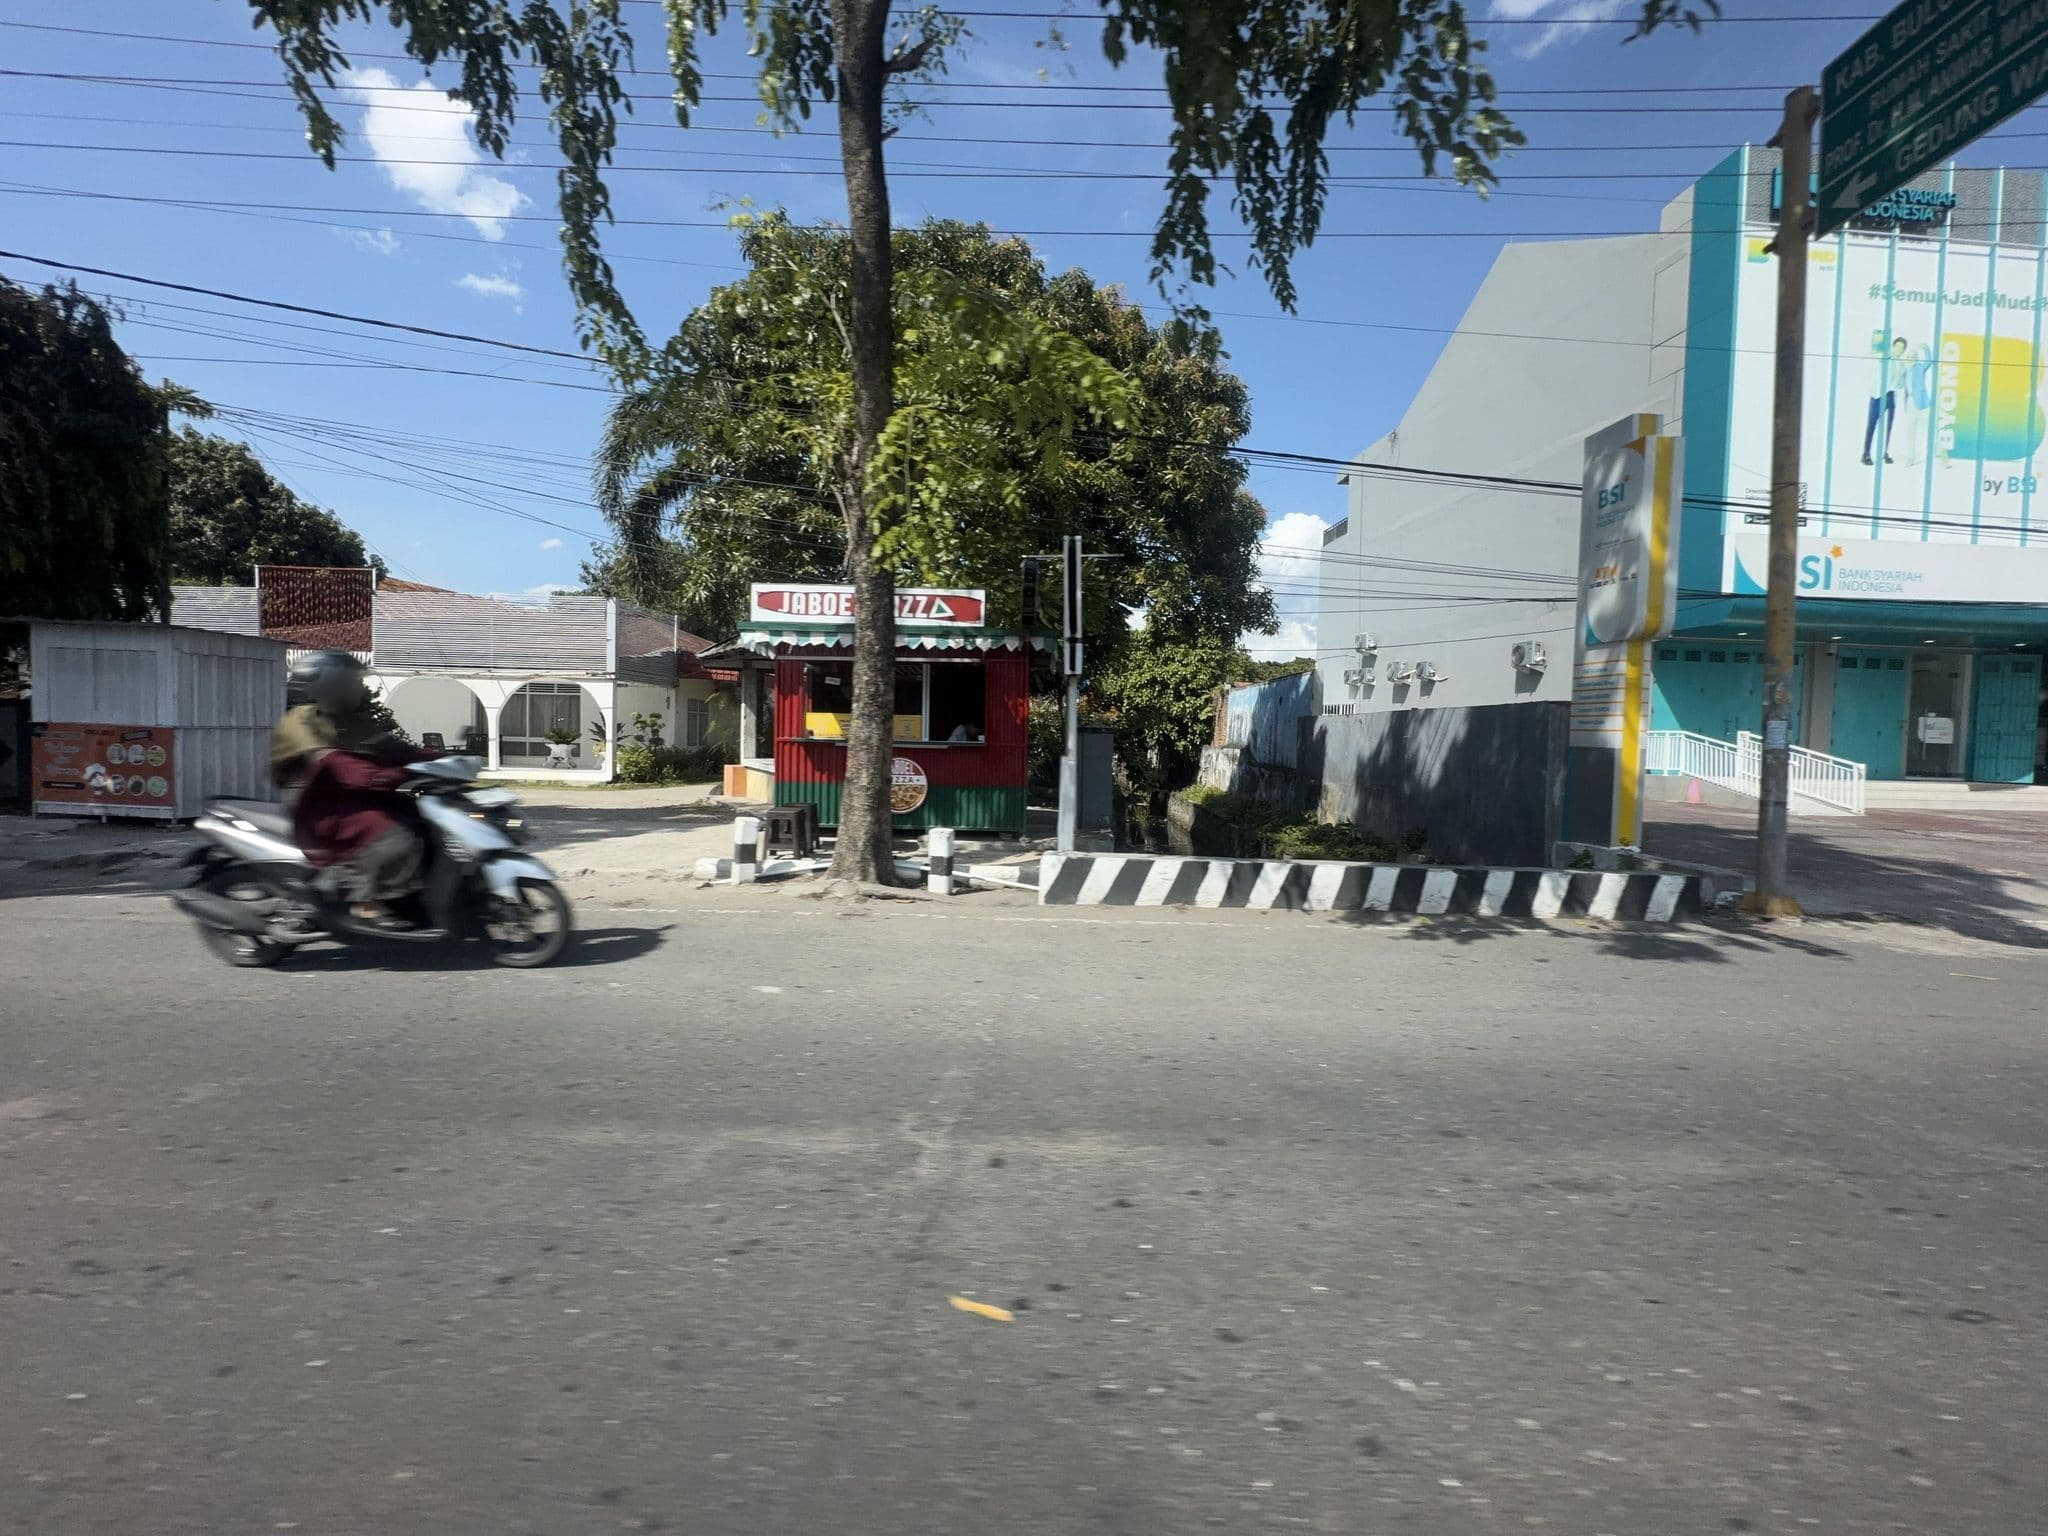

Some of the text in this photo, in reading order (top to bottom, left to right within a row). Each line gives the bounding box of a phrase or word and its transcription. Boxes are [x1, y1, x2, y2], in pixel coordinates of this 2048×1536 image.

[1895, 86, 2001, 172] GEDUNG
[1598, 480, 1625, 510] BSI
[1799, 554, 1833, 590] SI
[1839, 567, 1922, 582] BANK SYARIAH
[1838, 580, 1904, 593] INDONESIA
[777, 592, 956, 619] JABOE IZZA
